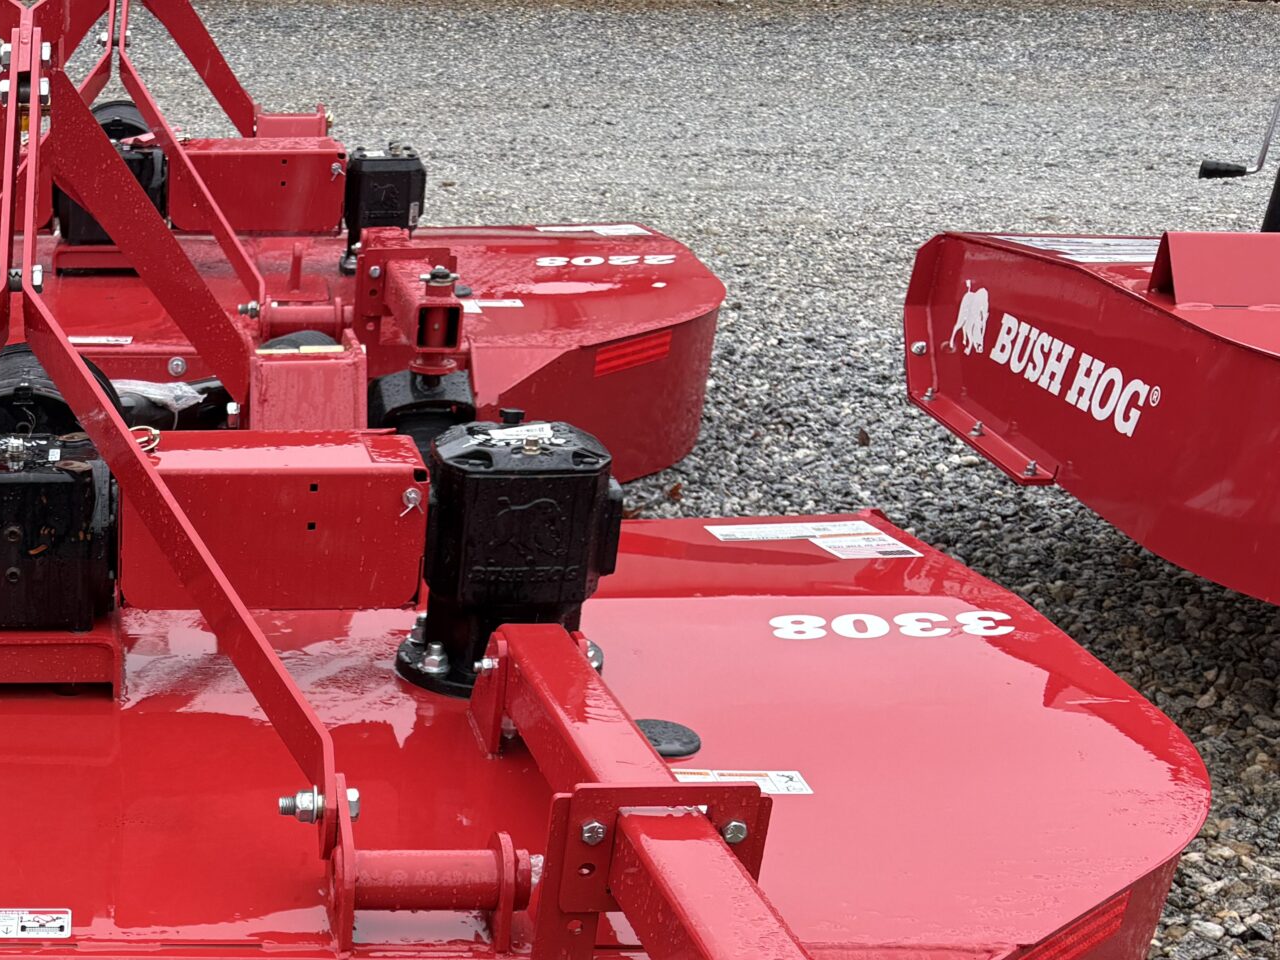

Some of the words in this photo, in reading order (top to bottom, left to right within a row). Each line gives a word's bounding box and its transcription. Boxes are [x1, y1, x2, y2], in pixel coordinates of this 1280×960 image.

[535, 254, 677, 267] 2208
[989, 312, 1076, 397] BUSH
[769, 611, 1016, 640] 3308
